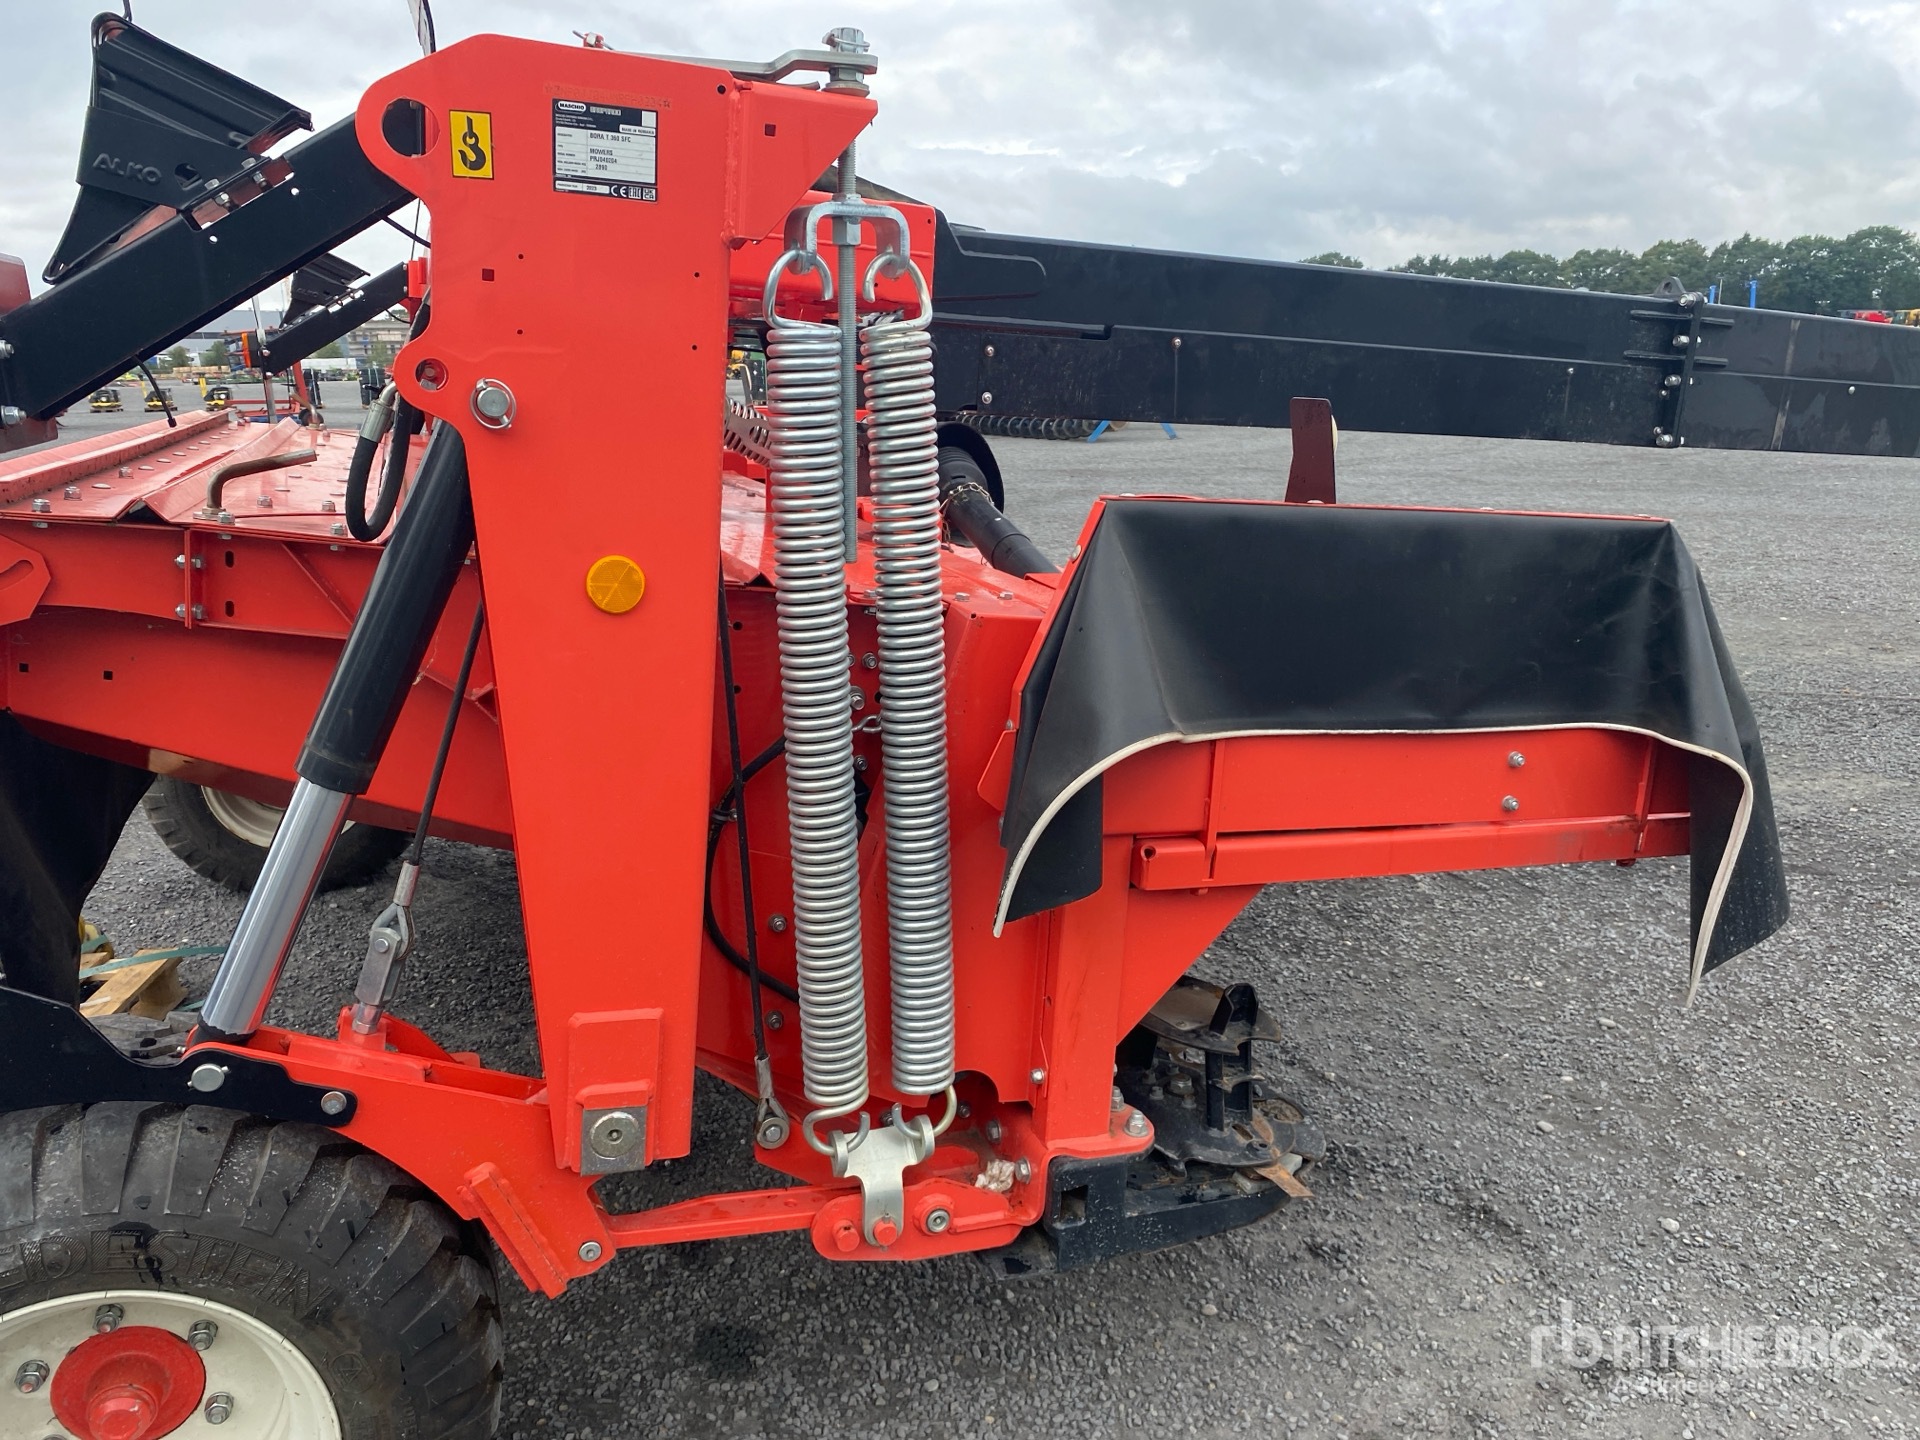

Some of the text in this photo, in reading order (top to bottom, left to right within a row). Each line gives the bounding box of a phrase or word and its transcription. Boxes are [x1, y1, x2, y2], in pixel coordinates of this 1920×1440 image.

[560, 102, 585, 110] MASCHIO
[590, 132, 604, 140] BORA
[590, 148, 613, 156] MOWERS
